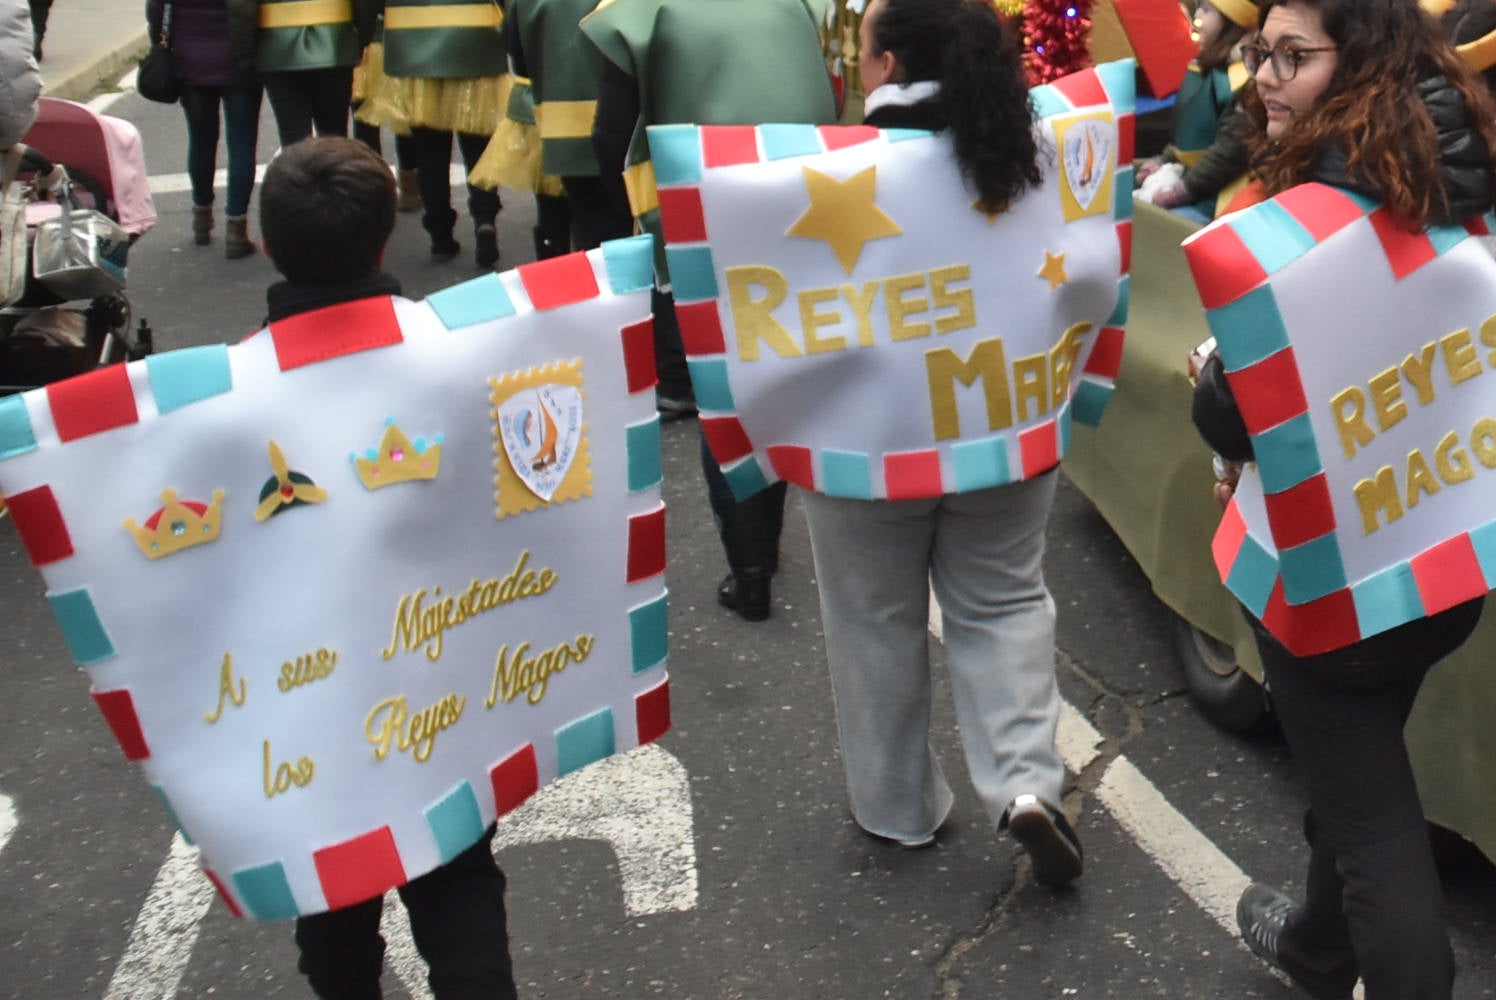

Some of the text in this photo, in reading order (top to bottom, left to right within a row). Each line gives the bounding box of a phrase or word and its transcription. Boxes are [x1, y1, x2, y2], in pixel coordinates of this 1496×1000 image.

[725, 264, 977, 362] REYES
[205, 549, 560, 725] A sus Majestades
[262, 633, 595, 798] los Reyes Magos
